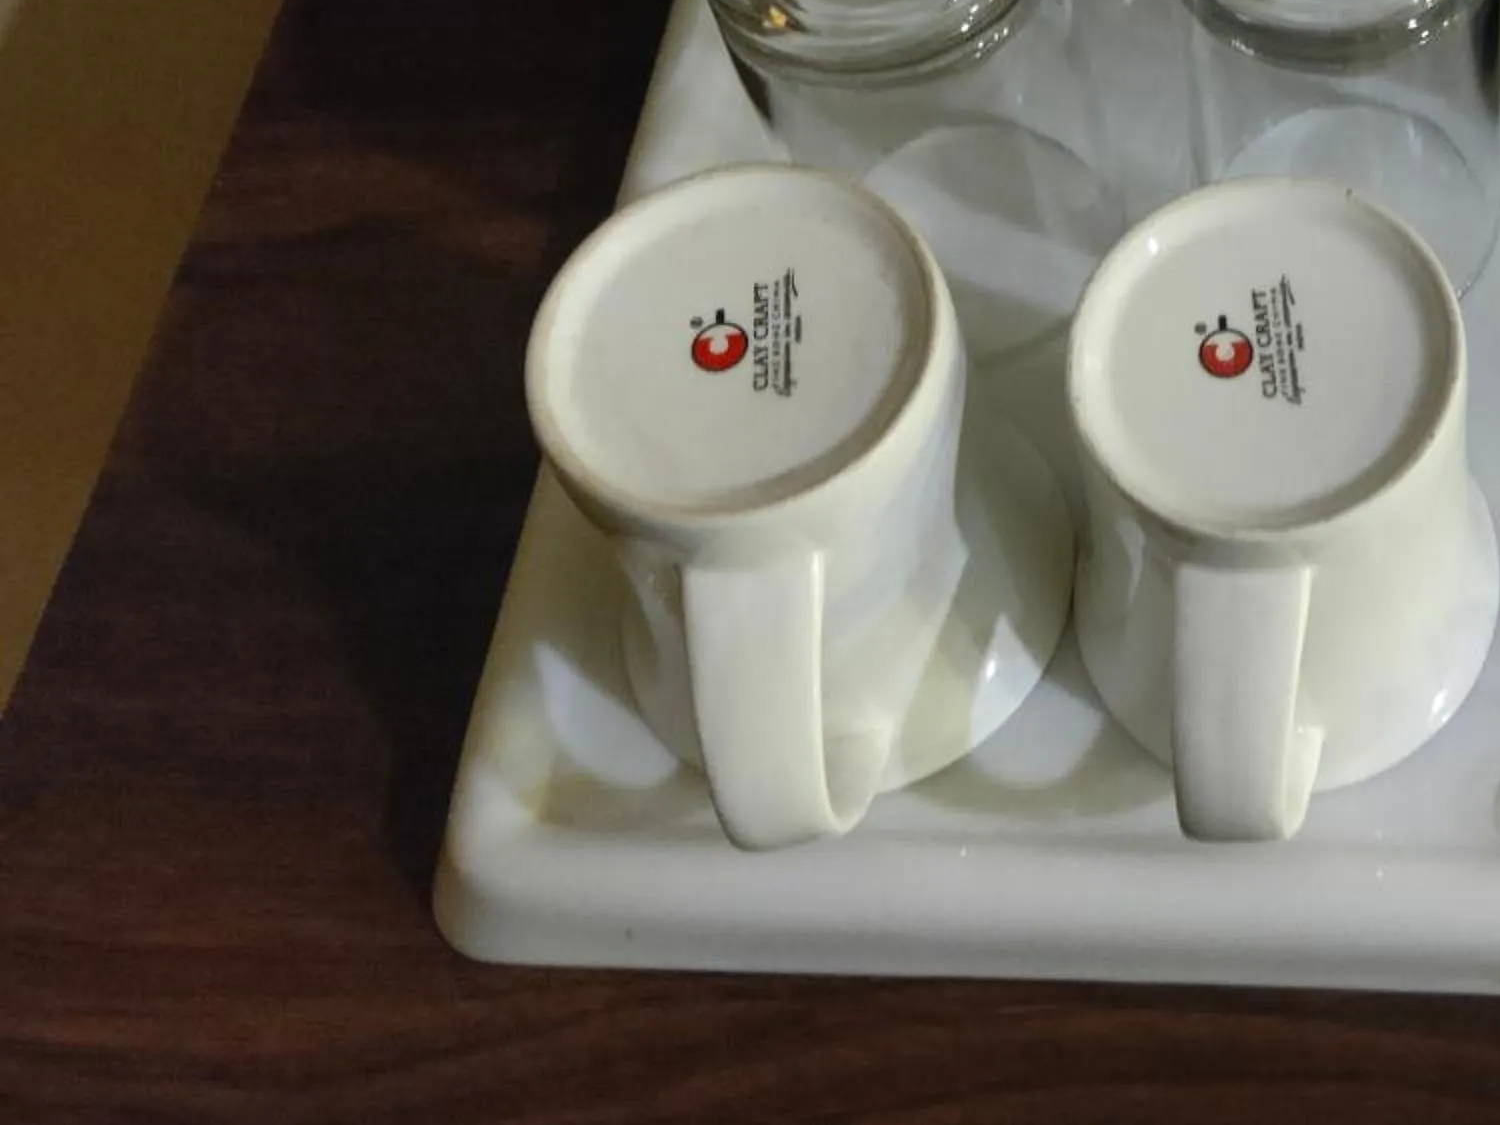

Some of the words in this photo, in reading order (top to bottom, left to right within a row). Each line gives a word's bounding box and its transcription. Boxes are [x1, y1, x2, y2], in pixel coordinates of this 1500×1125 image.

[753, 282, 769, 340] CRAFT
[1251, 288, 1272, 348] CRAFT
[753, 346, 769, 392] CLAY
[1259, 353, 1277, 399] CLAY
